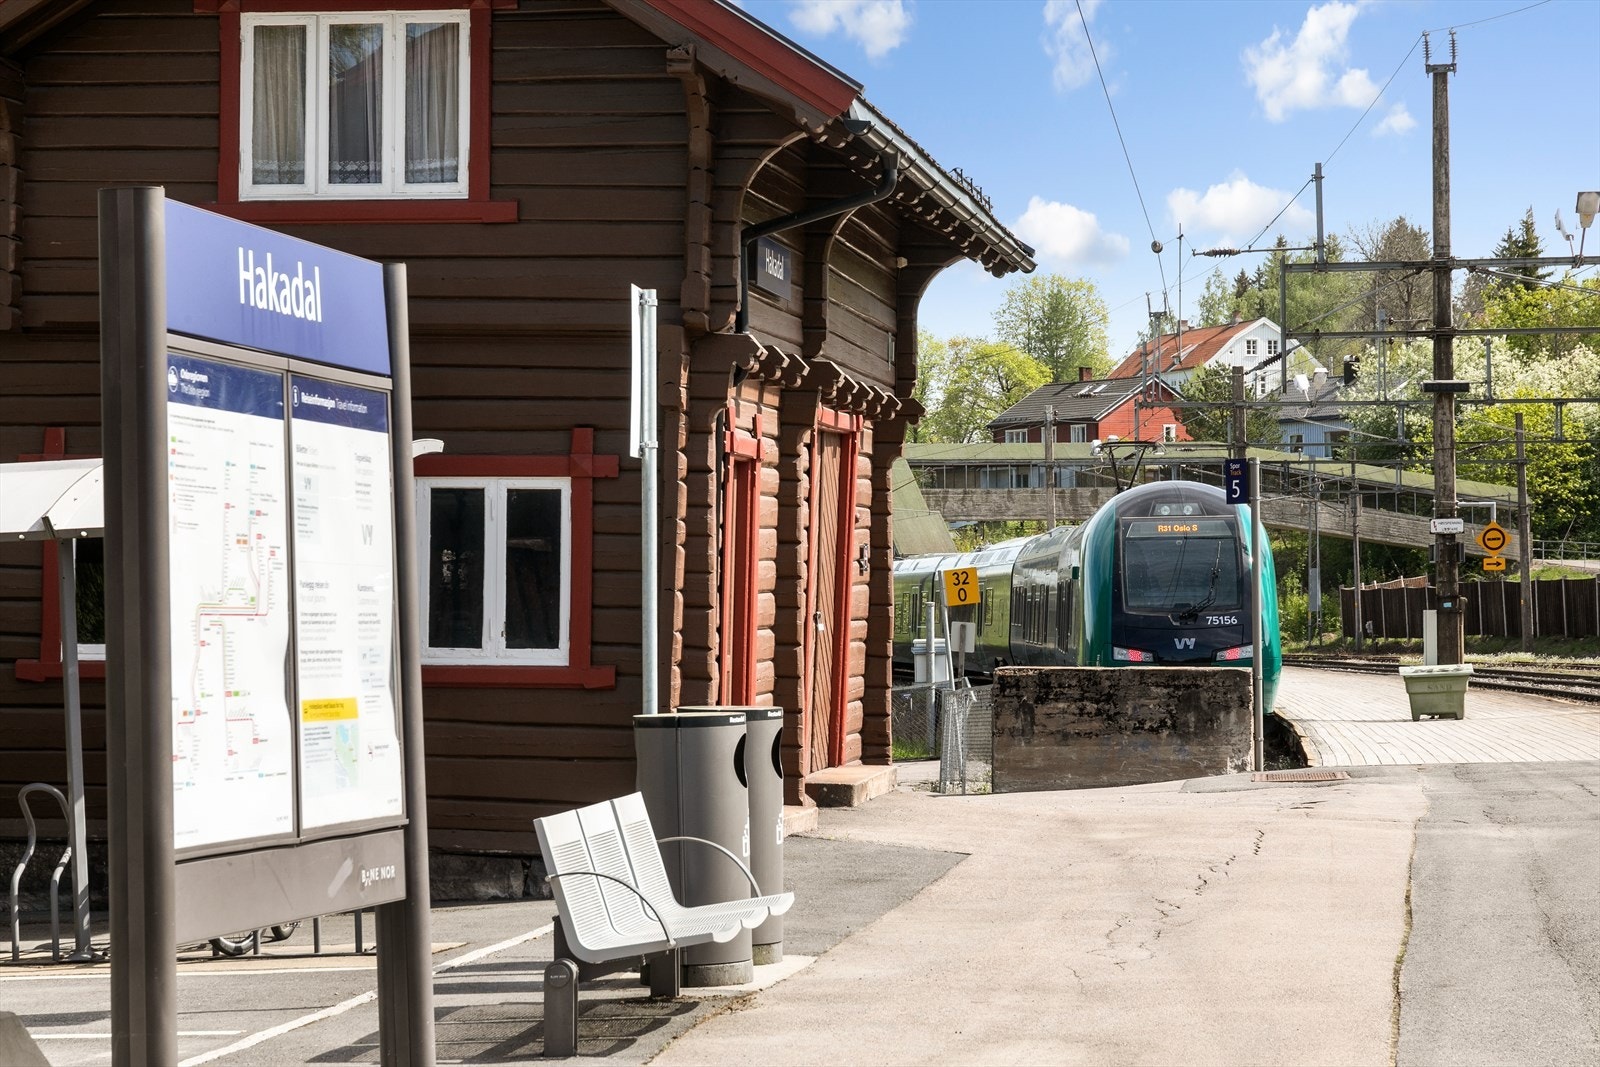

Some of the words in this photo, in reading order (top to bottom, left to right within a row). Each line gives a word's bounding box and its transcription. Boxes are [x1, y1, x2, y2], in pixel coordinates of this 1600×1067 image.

[765, 247, 784, 280] Hakadal
[238, 246, 322, 323] Hakadal
[1229, 462, 1241, 470] Spor
[1231, 479, 1240, 498] 5
[1157, 524, 1171, 532] R31
[1173, 524, 1191, 532] Oslo
[1192, 524, 1198, 532] S
[952, 570, 970, 586] 32
[957, 587, 967, 602] 0
[1205, 615, 1238, 625] 75156
[380, 865, 396, 880] NOR
